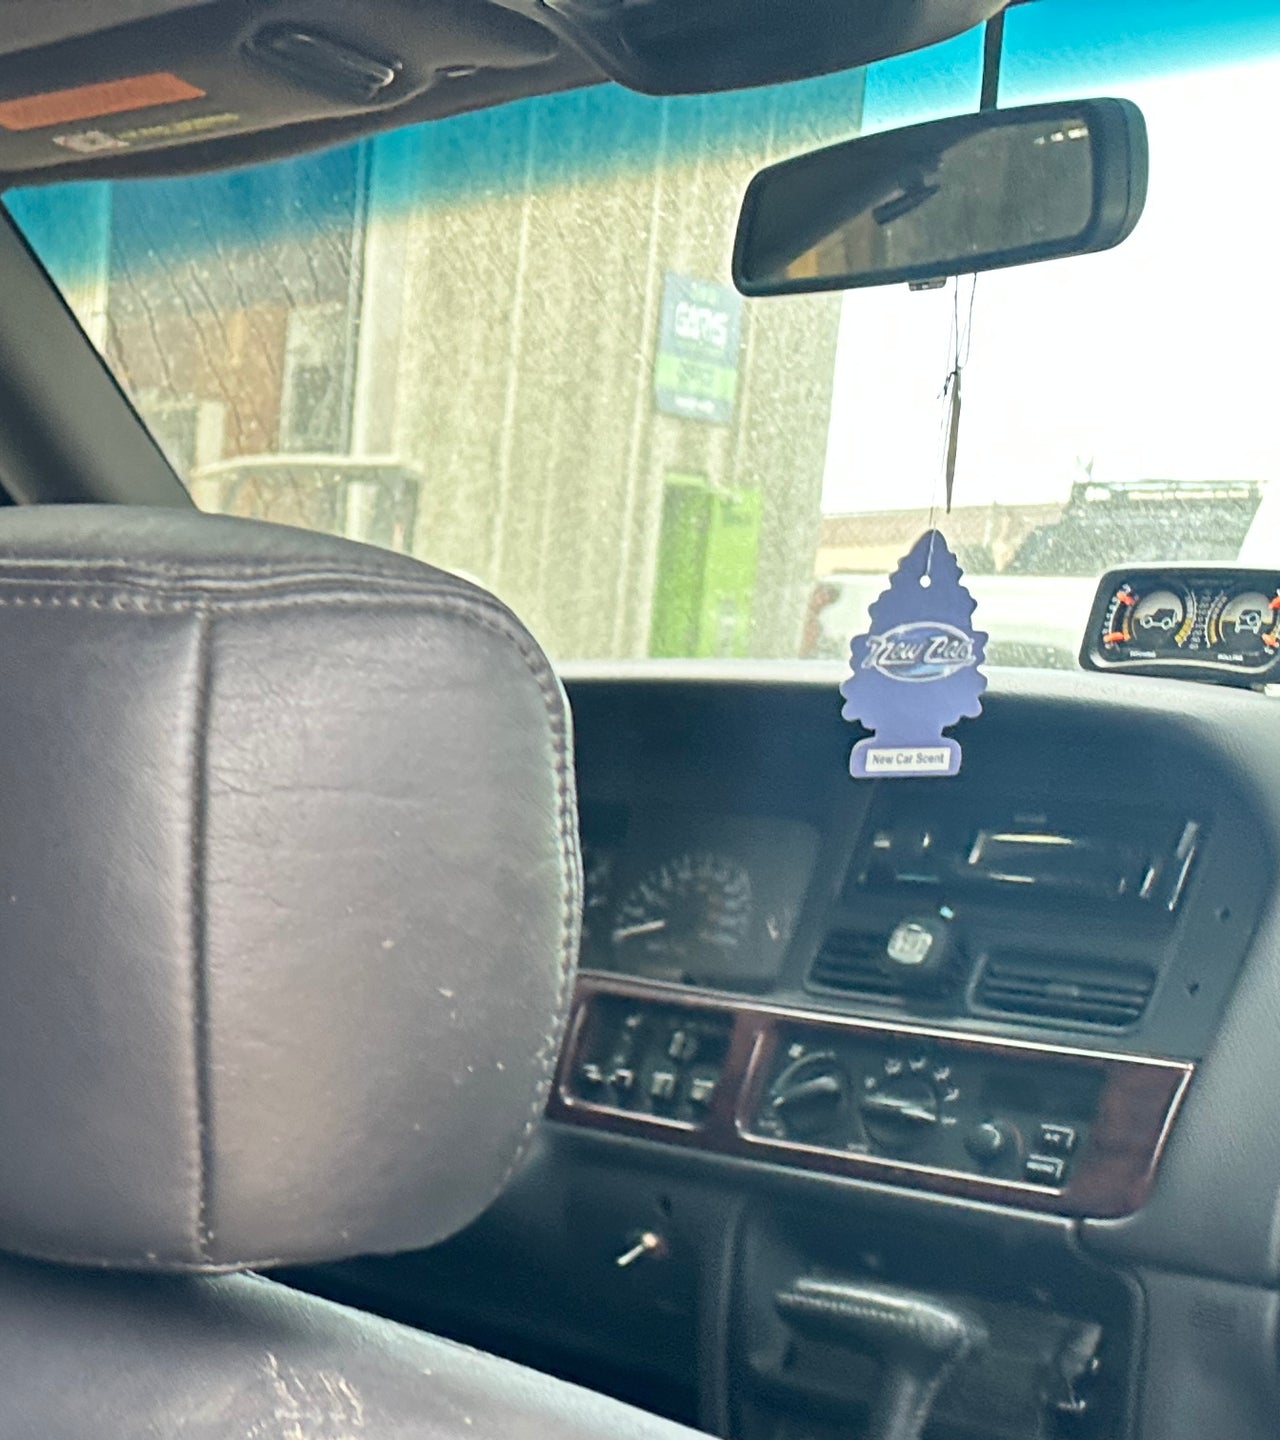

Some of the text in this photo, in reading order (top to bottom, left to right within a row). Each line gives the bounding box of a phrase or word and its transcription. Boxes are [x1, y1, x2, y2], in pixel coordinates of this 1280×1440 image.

[872, 751, 945, 765] New Car Scent
